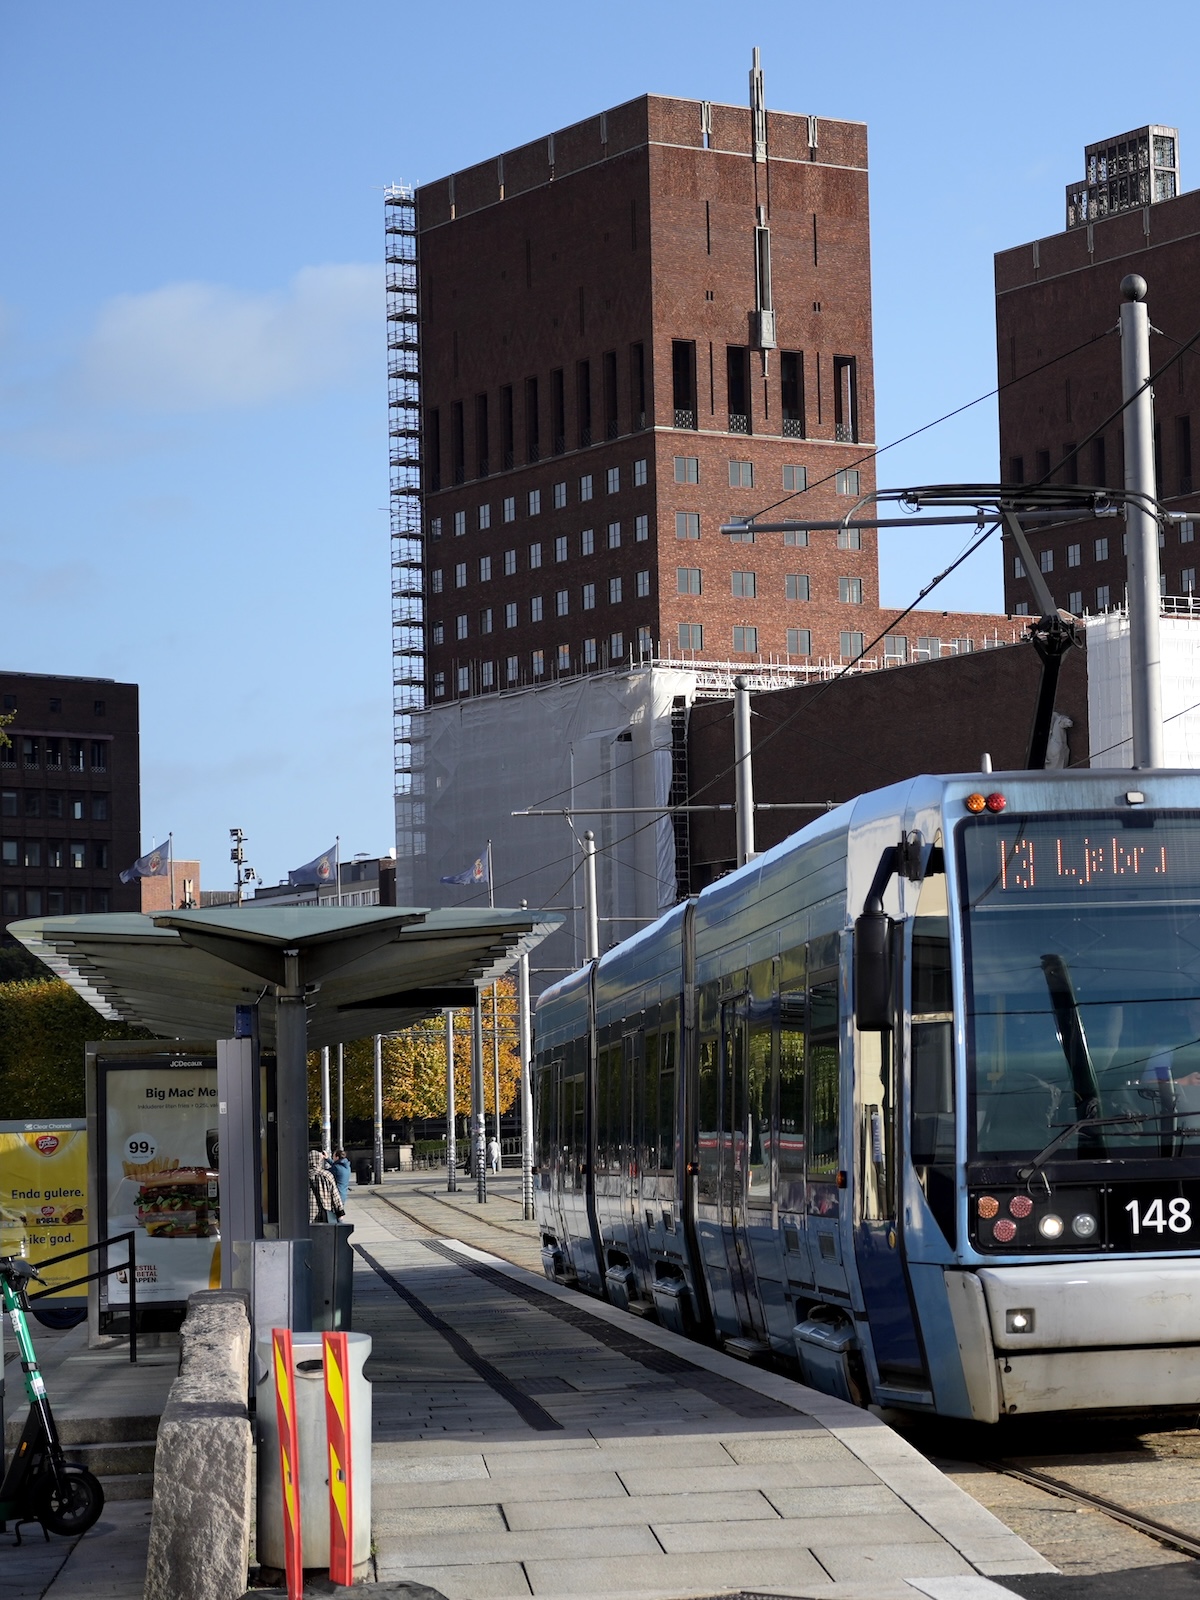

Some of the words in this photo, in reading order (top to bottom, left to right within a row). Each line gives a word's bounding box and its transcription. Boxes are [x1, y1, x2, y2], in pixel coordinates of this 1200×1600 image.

[169, 1060, 203, 1068] JCDecaux
[145, 1088, 166, 1101] Big
[168, 1088, 194, 1098] Mac
[198, 1087, 218, 1097] Me
[11, 1189, 40, 1199] Enda
[44, 1188, 84, 1201] gulere.
[1125, 1197, 1192, 1235] 148
[50, 1233, 75, 1245] god.
